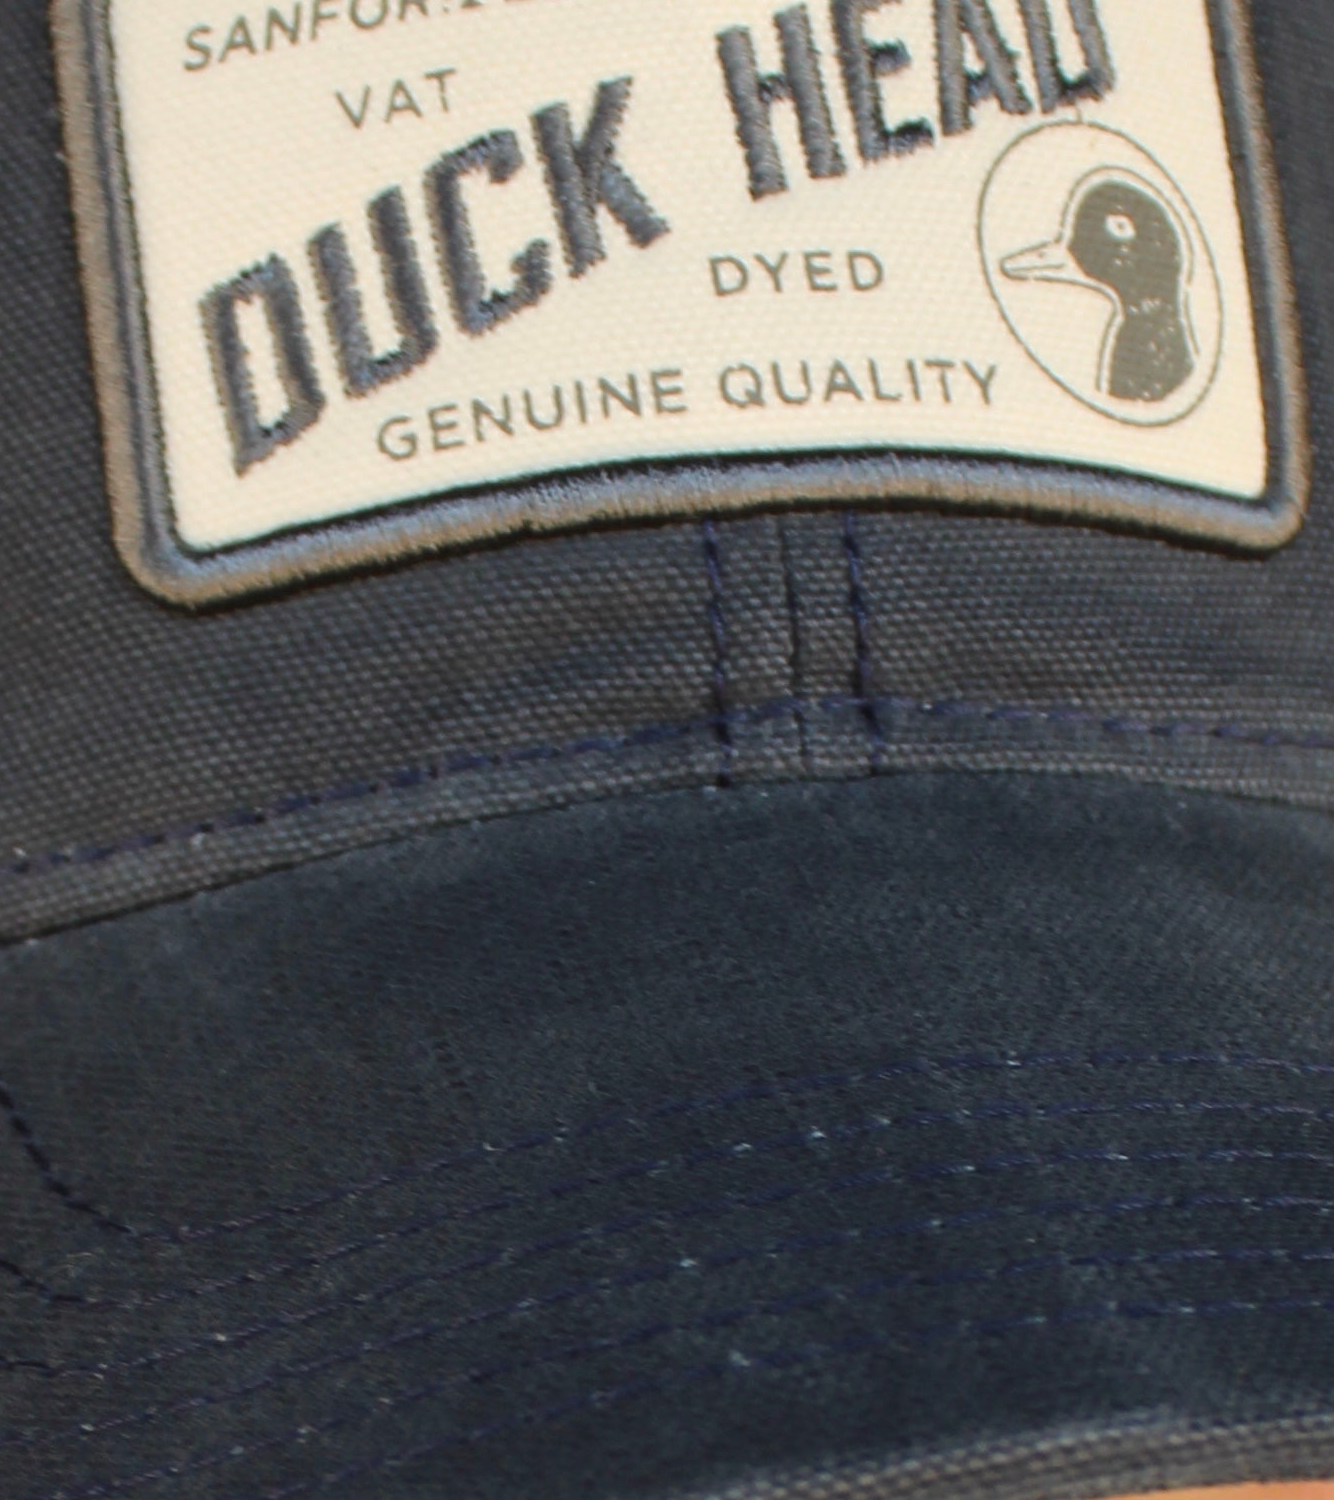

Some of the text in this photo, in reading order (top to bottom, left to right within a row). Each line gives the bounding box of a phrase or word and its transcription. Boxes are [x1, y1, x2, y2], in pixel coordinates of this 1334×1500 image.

[335, 67, 458, 130] VAT
[197, 75, 672, 480] DUCK
[707, 249, 885, 299] DYED
[375, 358, 1001, 463] GENUINE QUALITY
